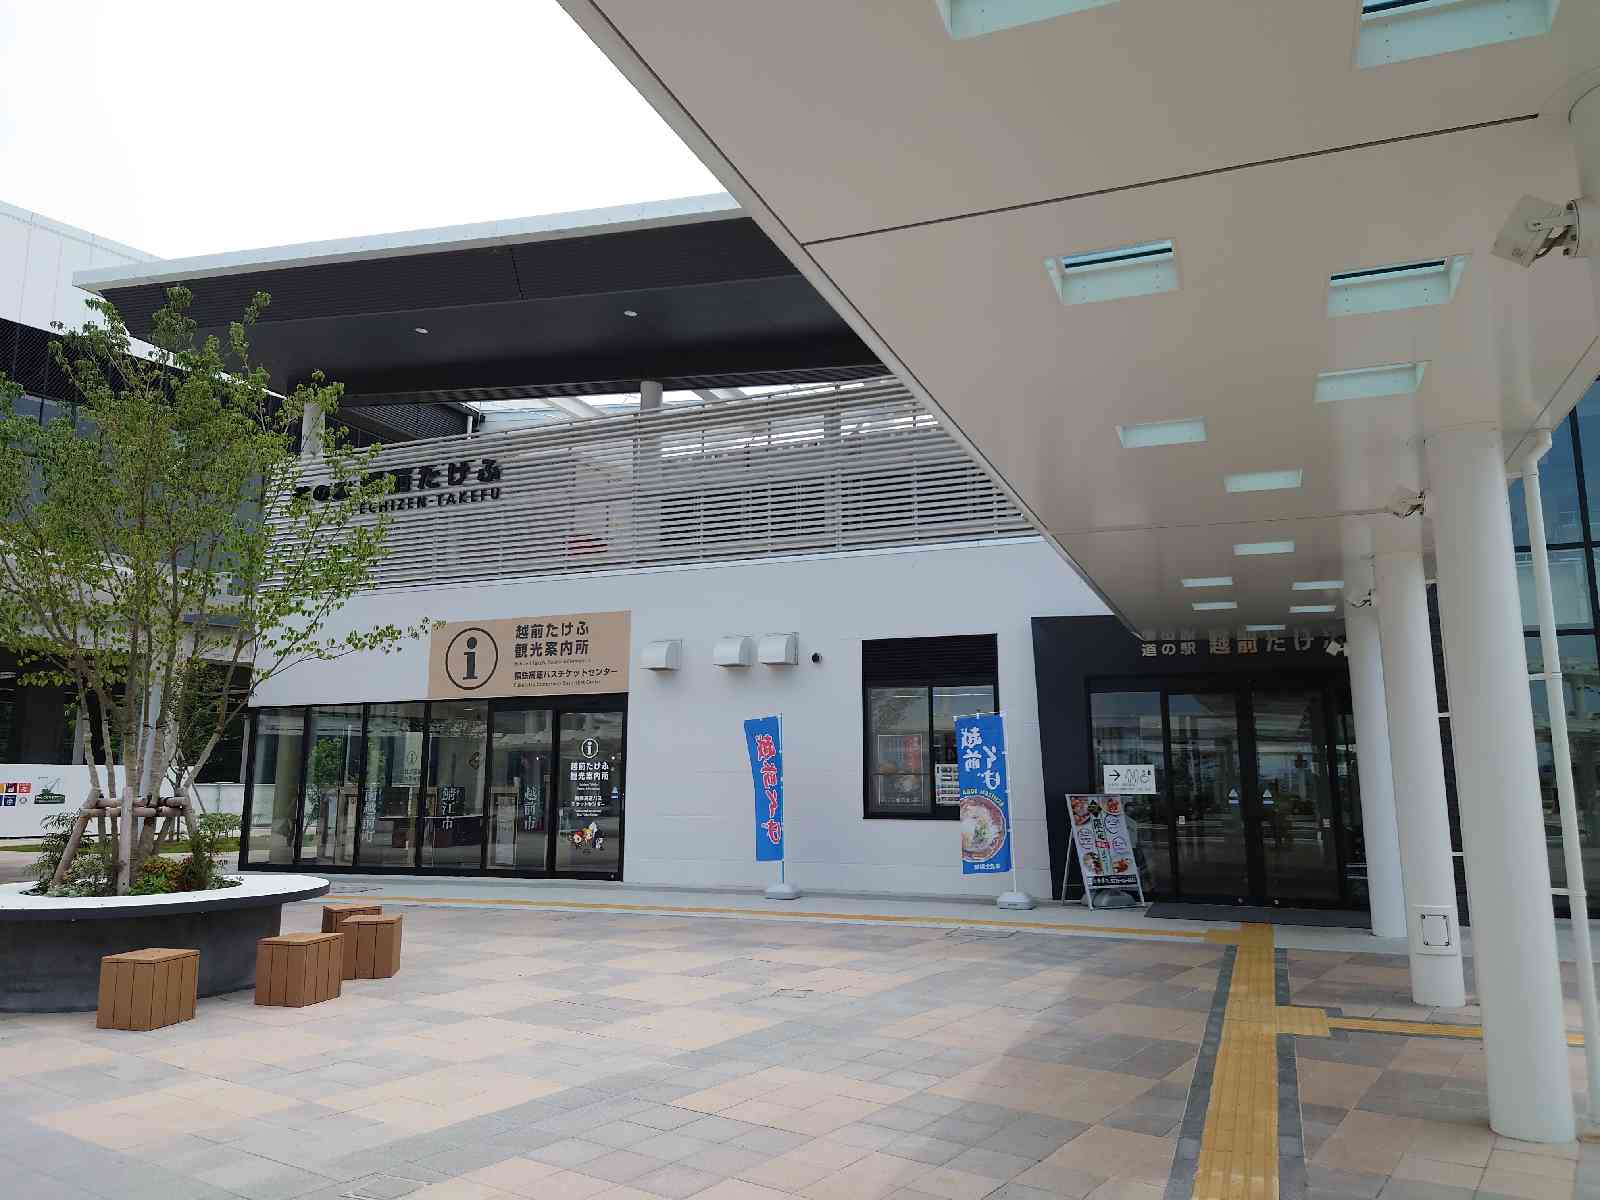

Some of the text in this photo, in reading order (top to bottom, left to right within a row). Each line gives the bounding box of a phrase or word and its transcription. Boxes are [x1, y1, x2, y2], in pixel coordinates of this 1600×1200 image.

[359, 486, 501, 513] ECHIZEN-TAKEFU
[515, 621, 589, 640] 越前たけふ
[514, 639, 589, 658] 観光案内所
[1209, 637, 1331, 656] 越前たけ
